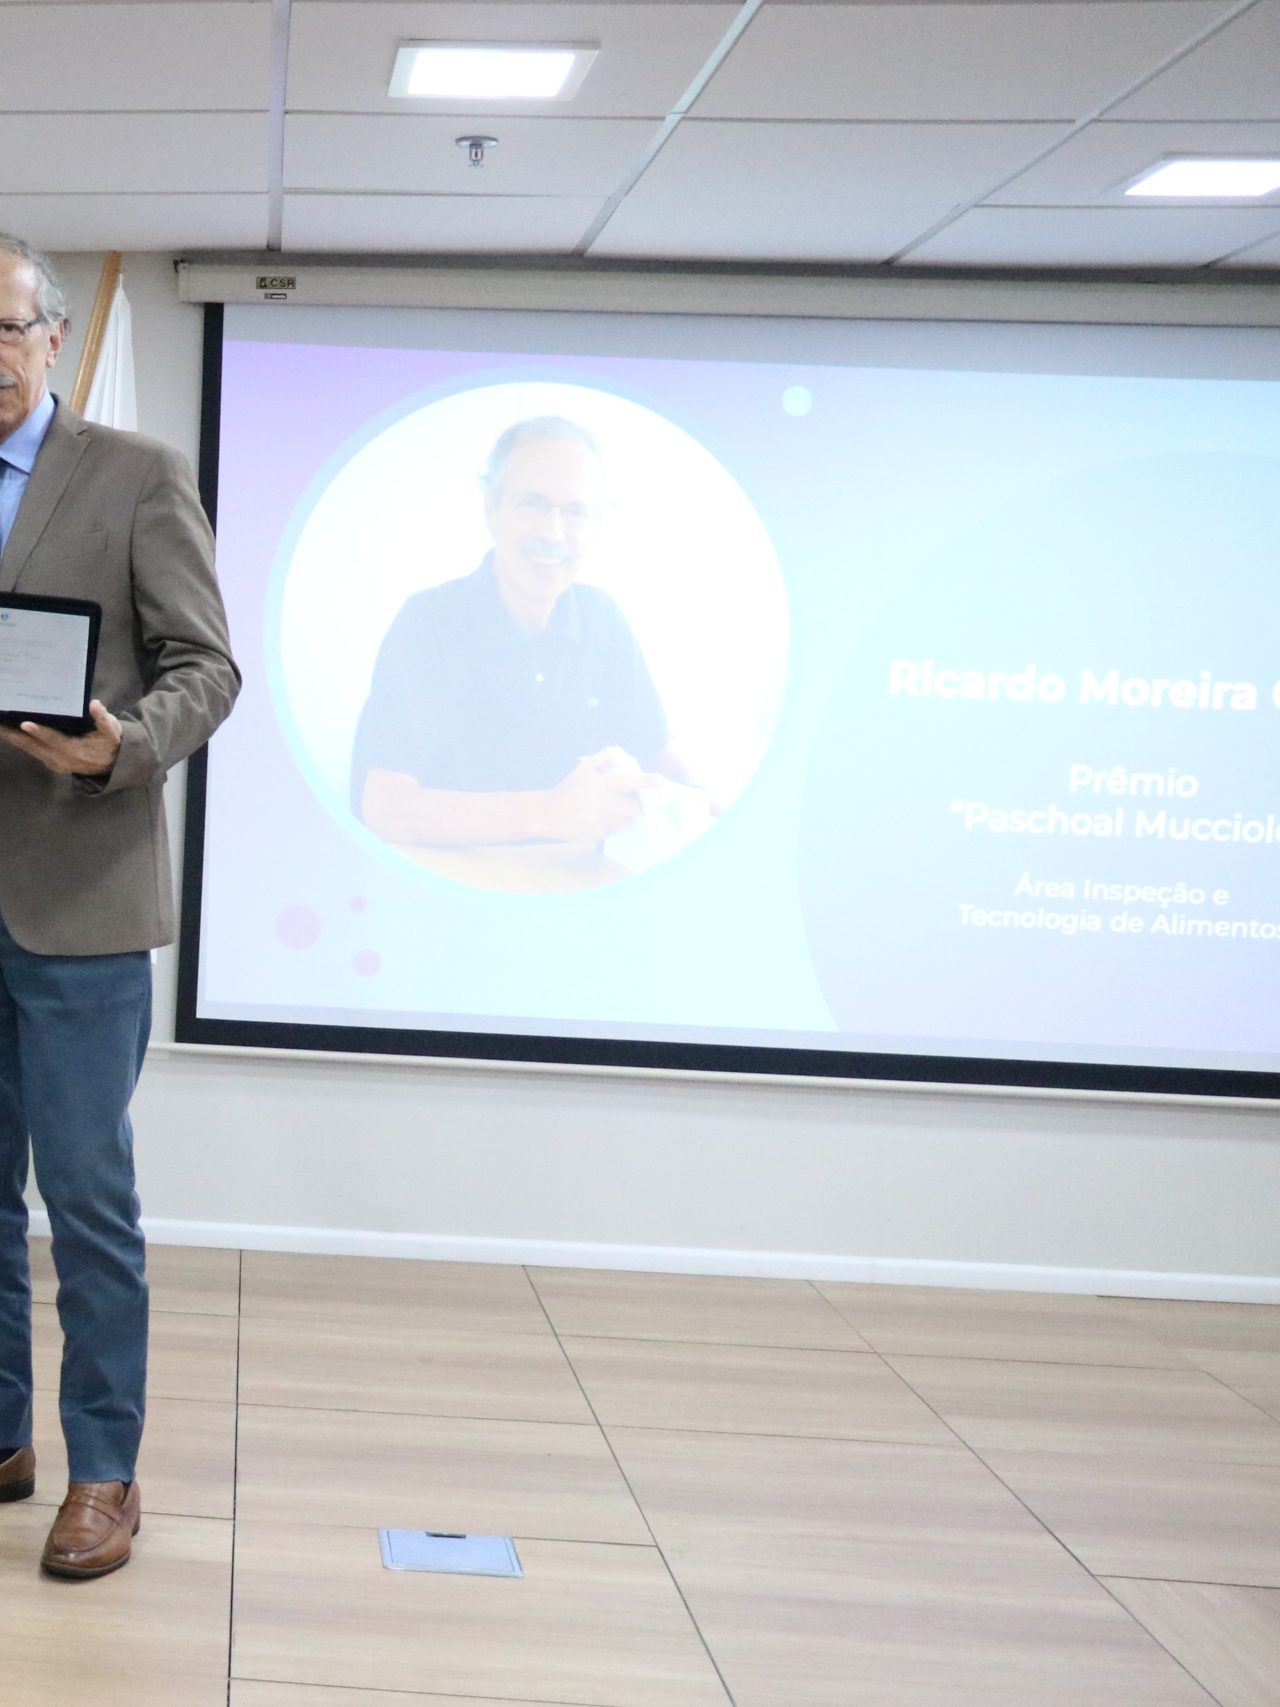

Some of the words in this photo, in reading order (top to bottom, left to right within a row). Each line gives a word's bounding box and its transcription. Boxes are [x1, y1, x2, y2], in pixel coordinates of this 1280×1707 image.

[888, 658, 1067, 704] Ricardo
[1079, 668, 1258, 711] Moreira
[1068, 763, 1200, 798] Prêmio
[1135, 810, 1280, 844] Mucciol
[1014, 870, 1076, 899] Área
[1084, 879, 1205, 908] Inspeção
[1212, 888, 1230, 905] e
[958, 904, 1101, 934] Tecnologia
[1109, 912, 1144, 934] de
